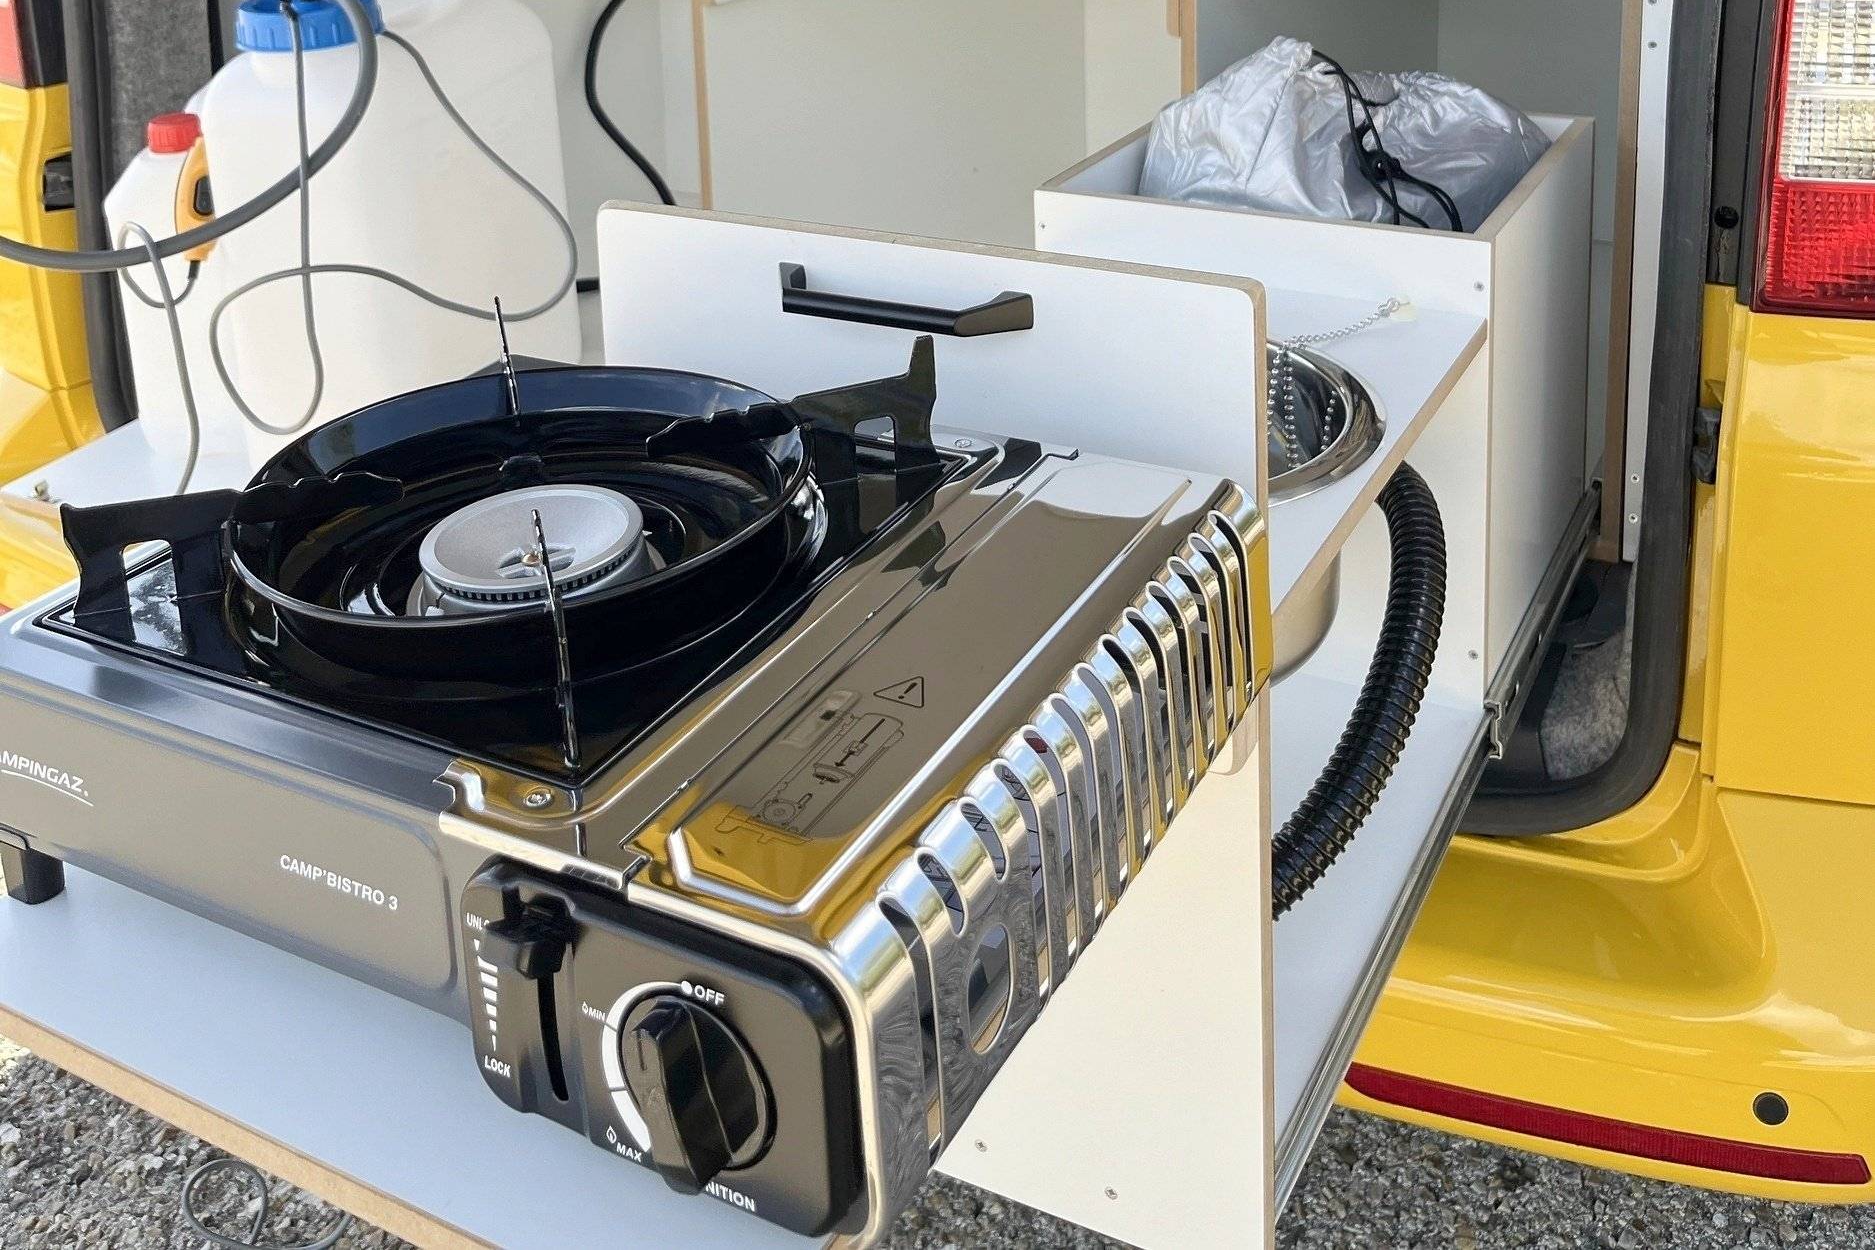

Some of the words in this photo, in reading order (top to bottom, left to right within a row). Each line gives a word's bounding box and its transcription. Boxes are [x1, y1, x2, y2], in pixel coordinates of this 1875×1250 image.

[0, 750, 84, 792] MPINGAZ
[279, 854, 385, 905] CAMP'BISTRO
[388, 895, 398, 910] 3
[466, 912, 490, 930] UNL
[694, 985, 725, 1006] OFF
[588, 1007, 606, 1022] MIN
[484, 1055, 511, 1078] LOCK
[616, 1143, 642, 1162] MAX
[705, 1181, 756, 1212] NITION
